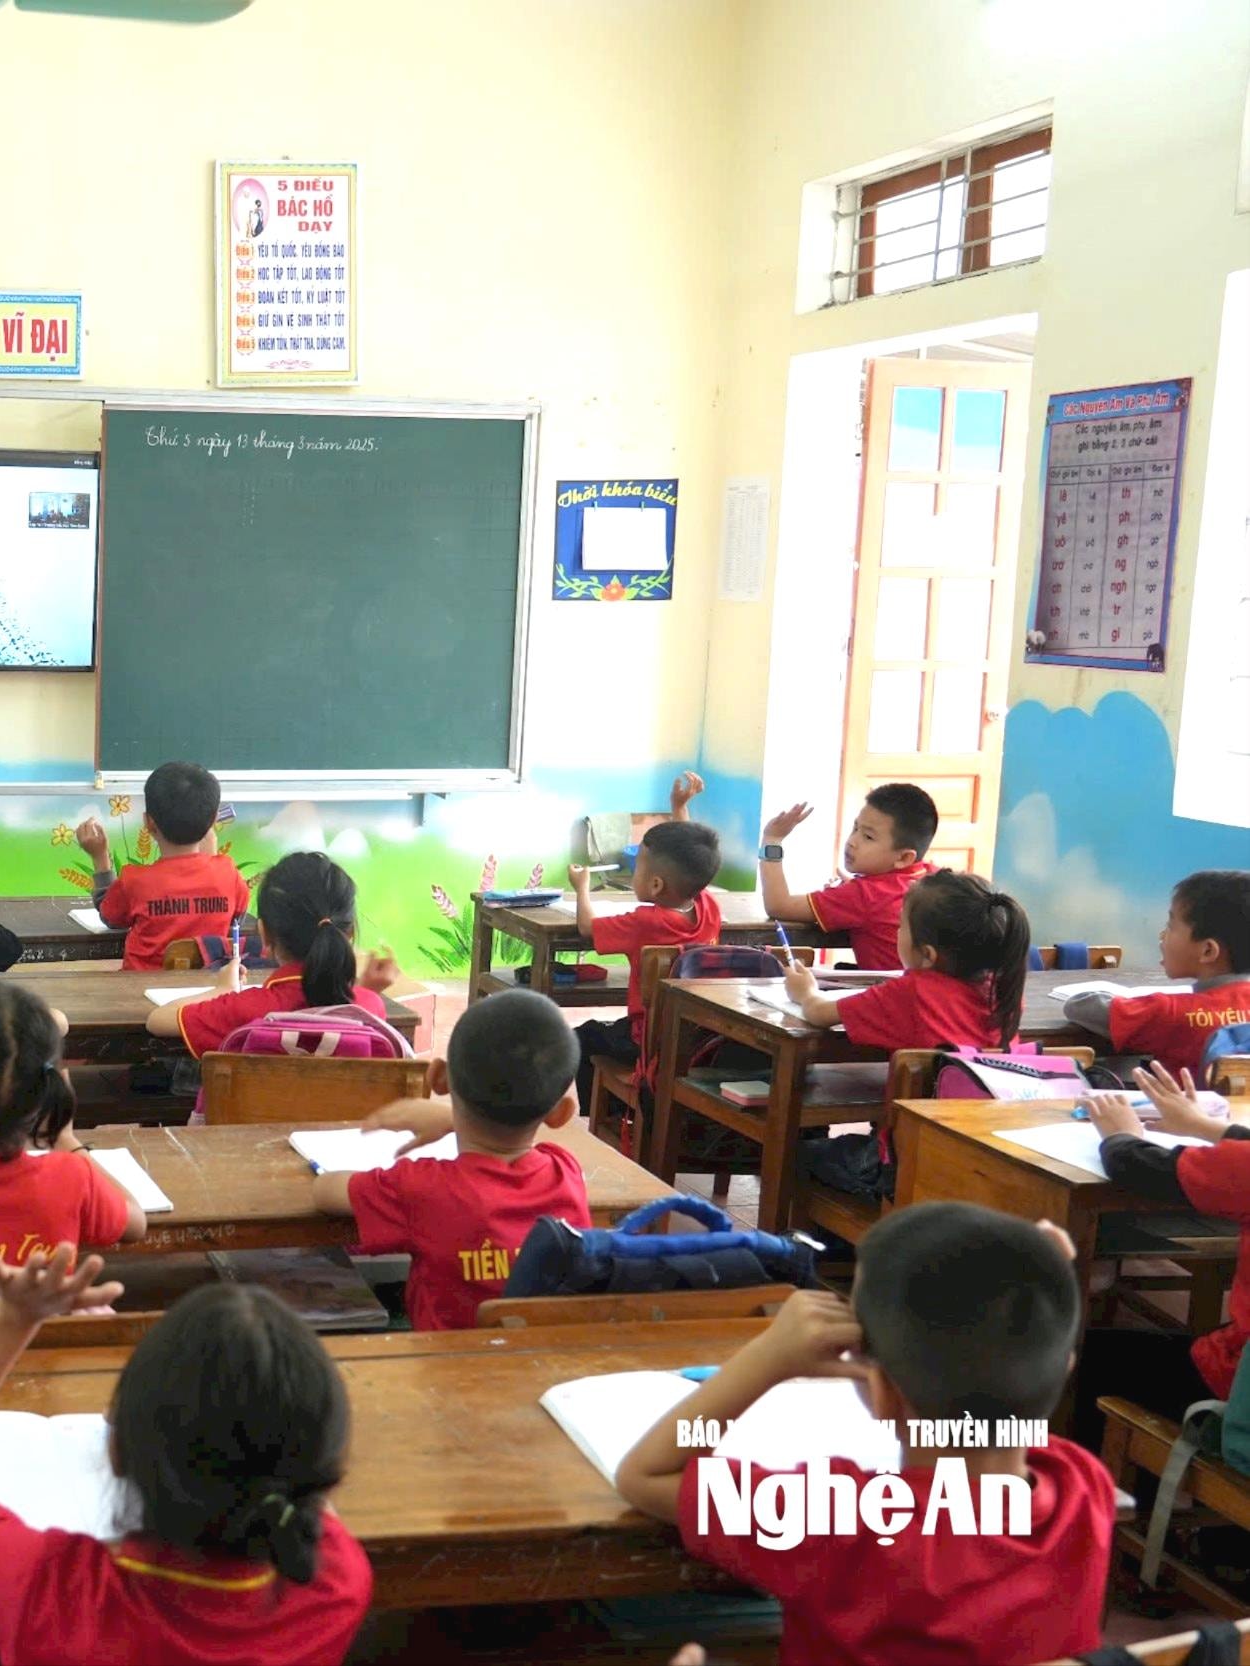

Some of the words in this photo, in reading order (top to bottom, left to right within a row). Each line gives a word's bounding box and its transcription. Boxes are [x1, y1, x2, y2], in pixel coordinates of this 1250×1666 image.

[278, 180, 288, 191] 5
[294, 177, 333, 191] ĐIỀU
[278, 196, 307, 216] BÁC
[313, 194, 333, 216] HỒ
[298, 221, 332, 234] DẠY
[2, 312, 24, 353] VĨ
[30, 319, 67, 362] ĐẠI
[145, 426, 178, 446] Thứ
[183, 434, 191, 447] 5
[197, 432, 232, 457] ngày
[237, 434, 247, 448] 13
[253, 429, 294, 459] tháng
[299, 436, 305, 450] 3
[306, 437, 342, 450] năm
[557, 485, 599, 508] Thời
[602, 482, 643, 498] khóa
[645, 483, 678, 506] biểu
[1119, 510, 1130, 526] ph
[1118, 534, 1128, 548] gh
[1115, 559, 1126, 572] ng
[1111, 580, 1127, 595] ngh
[1114, 604, 1121, 615] tr
[147, 895, 189, 916] THÀNH
[193, 897, 228, 914] TRUNG
[1185, 1008, 1214, 1027] TÔI
[1215, 1007, 1246, 1025] YÊU
